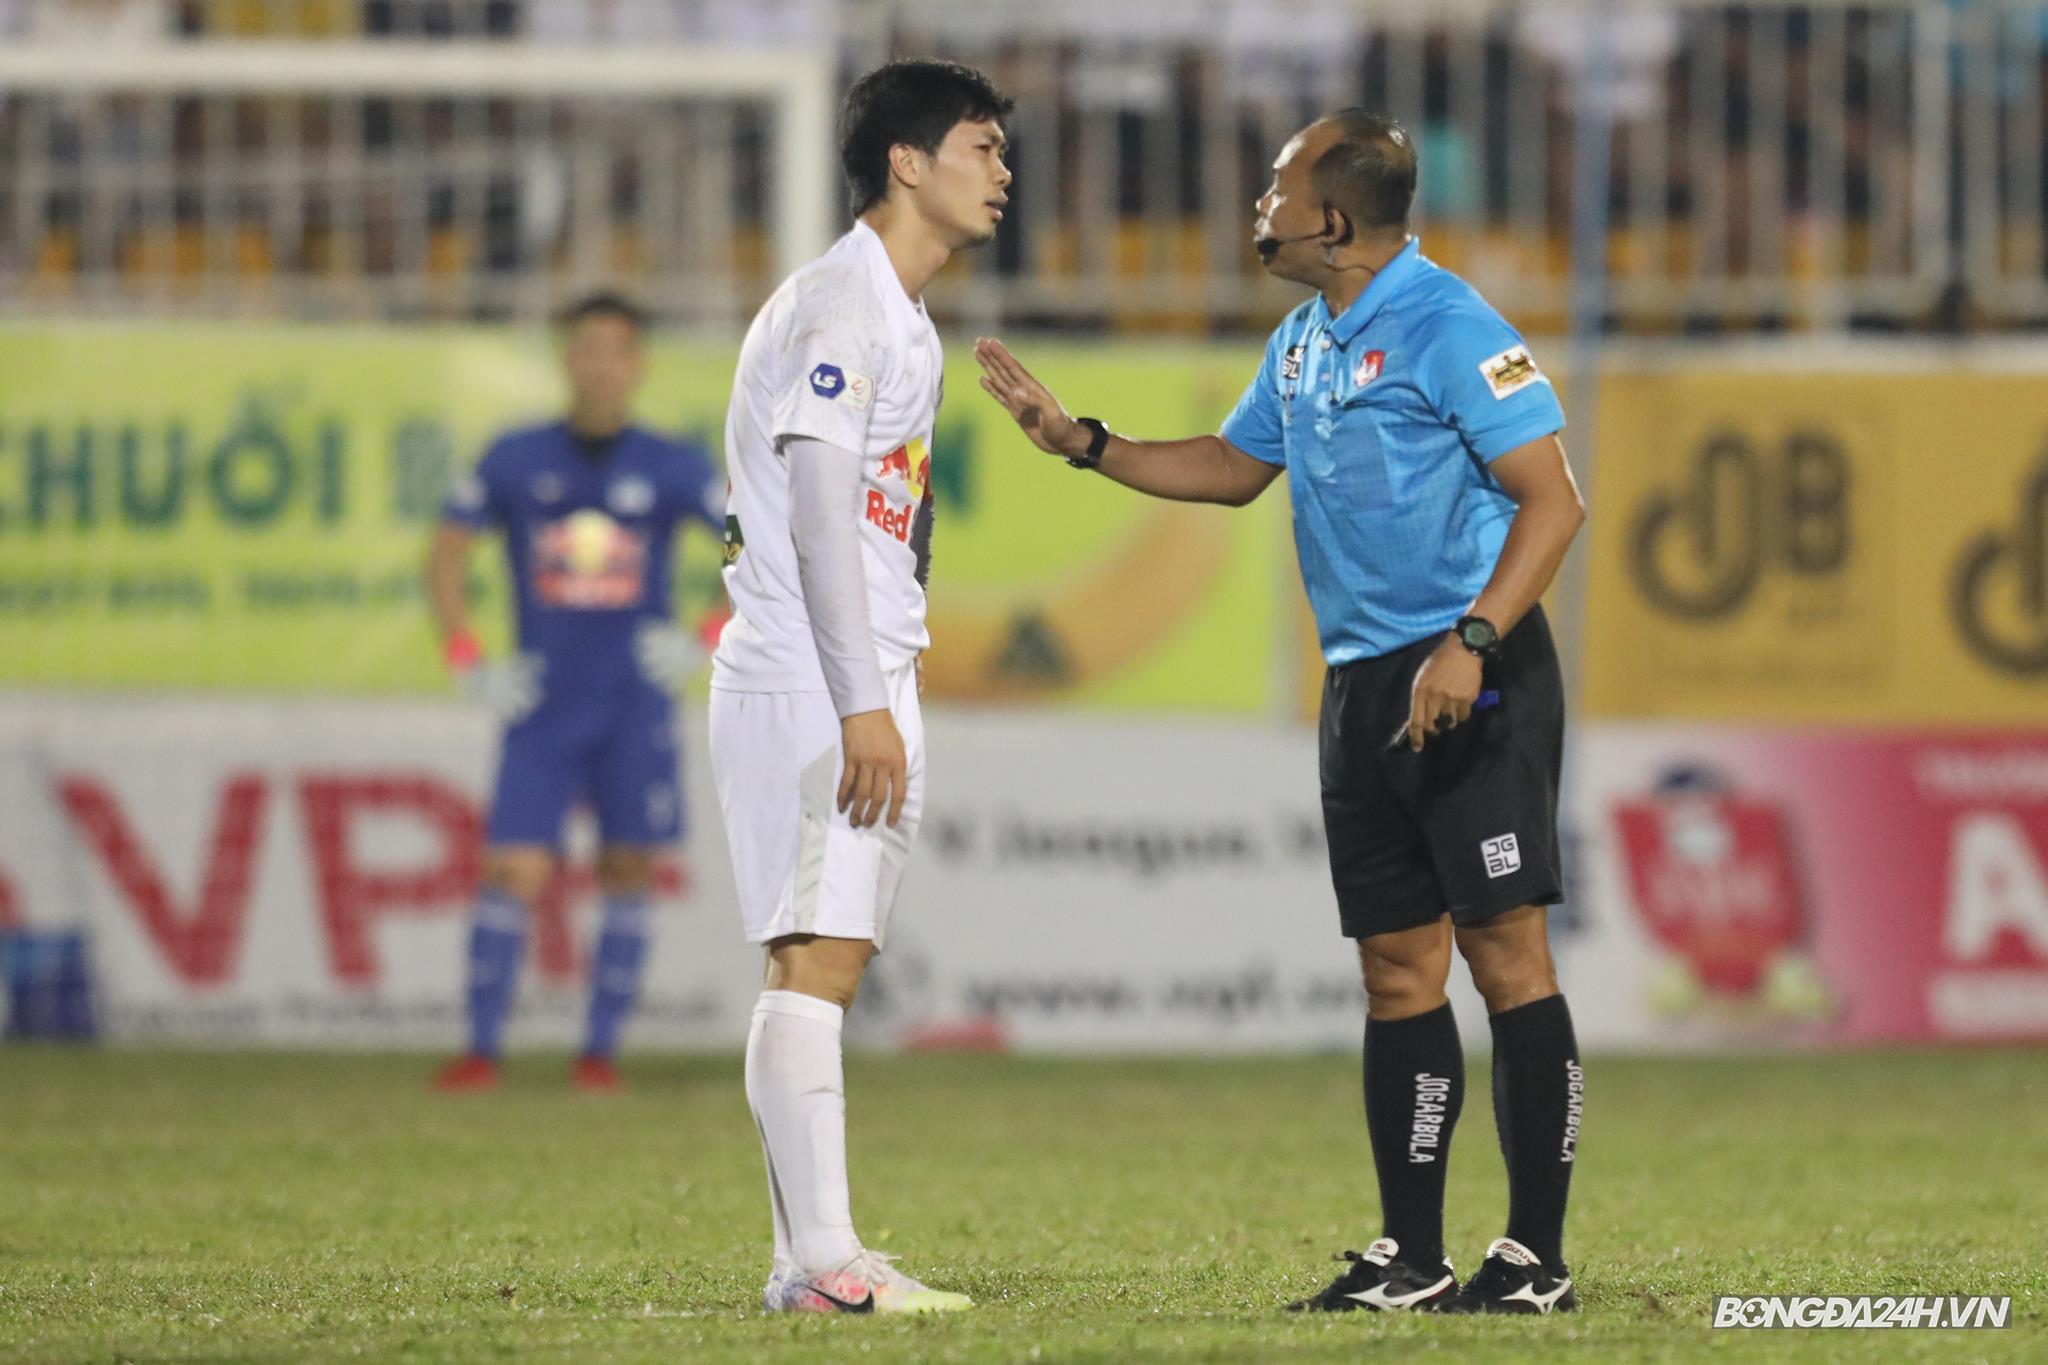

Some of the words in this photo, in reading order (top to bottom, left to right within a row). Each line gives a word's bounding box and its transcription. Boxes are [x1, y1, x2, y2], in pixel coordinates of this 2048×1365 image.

[0, 382, 344, 530] HUỐI
[866, 489, 912, 542] Red
[1408, 1073, 1450, 1163] JOGARBOLA
[1560, 1060, 1584, 1162] JOGARBOLA
